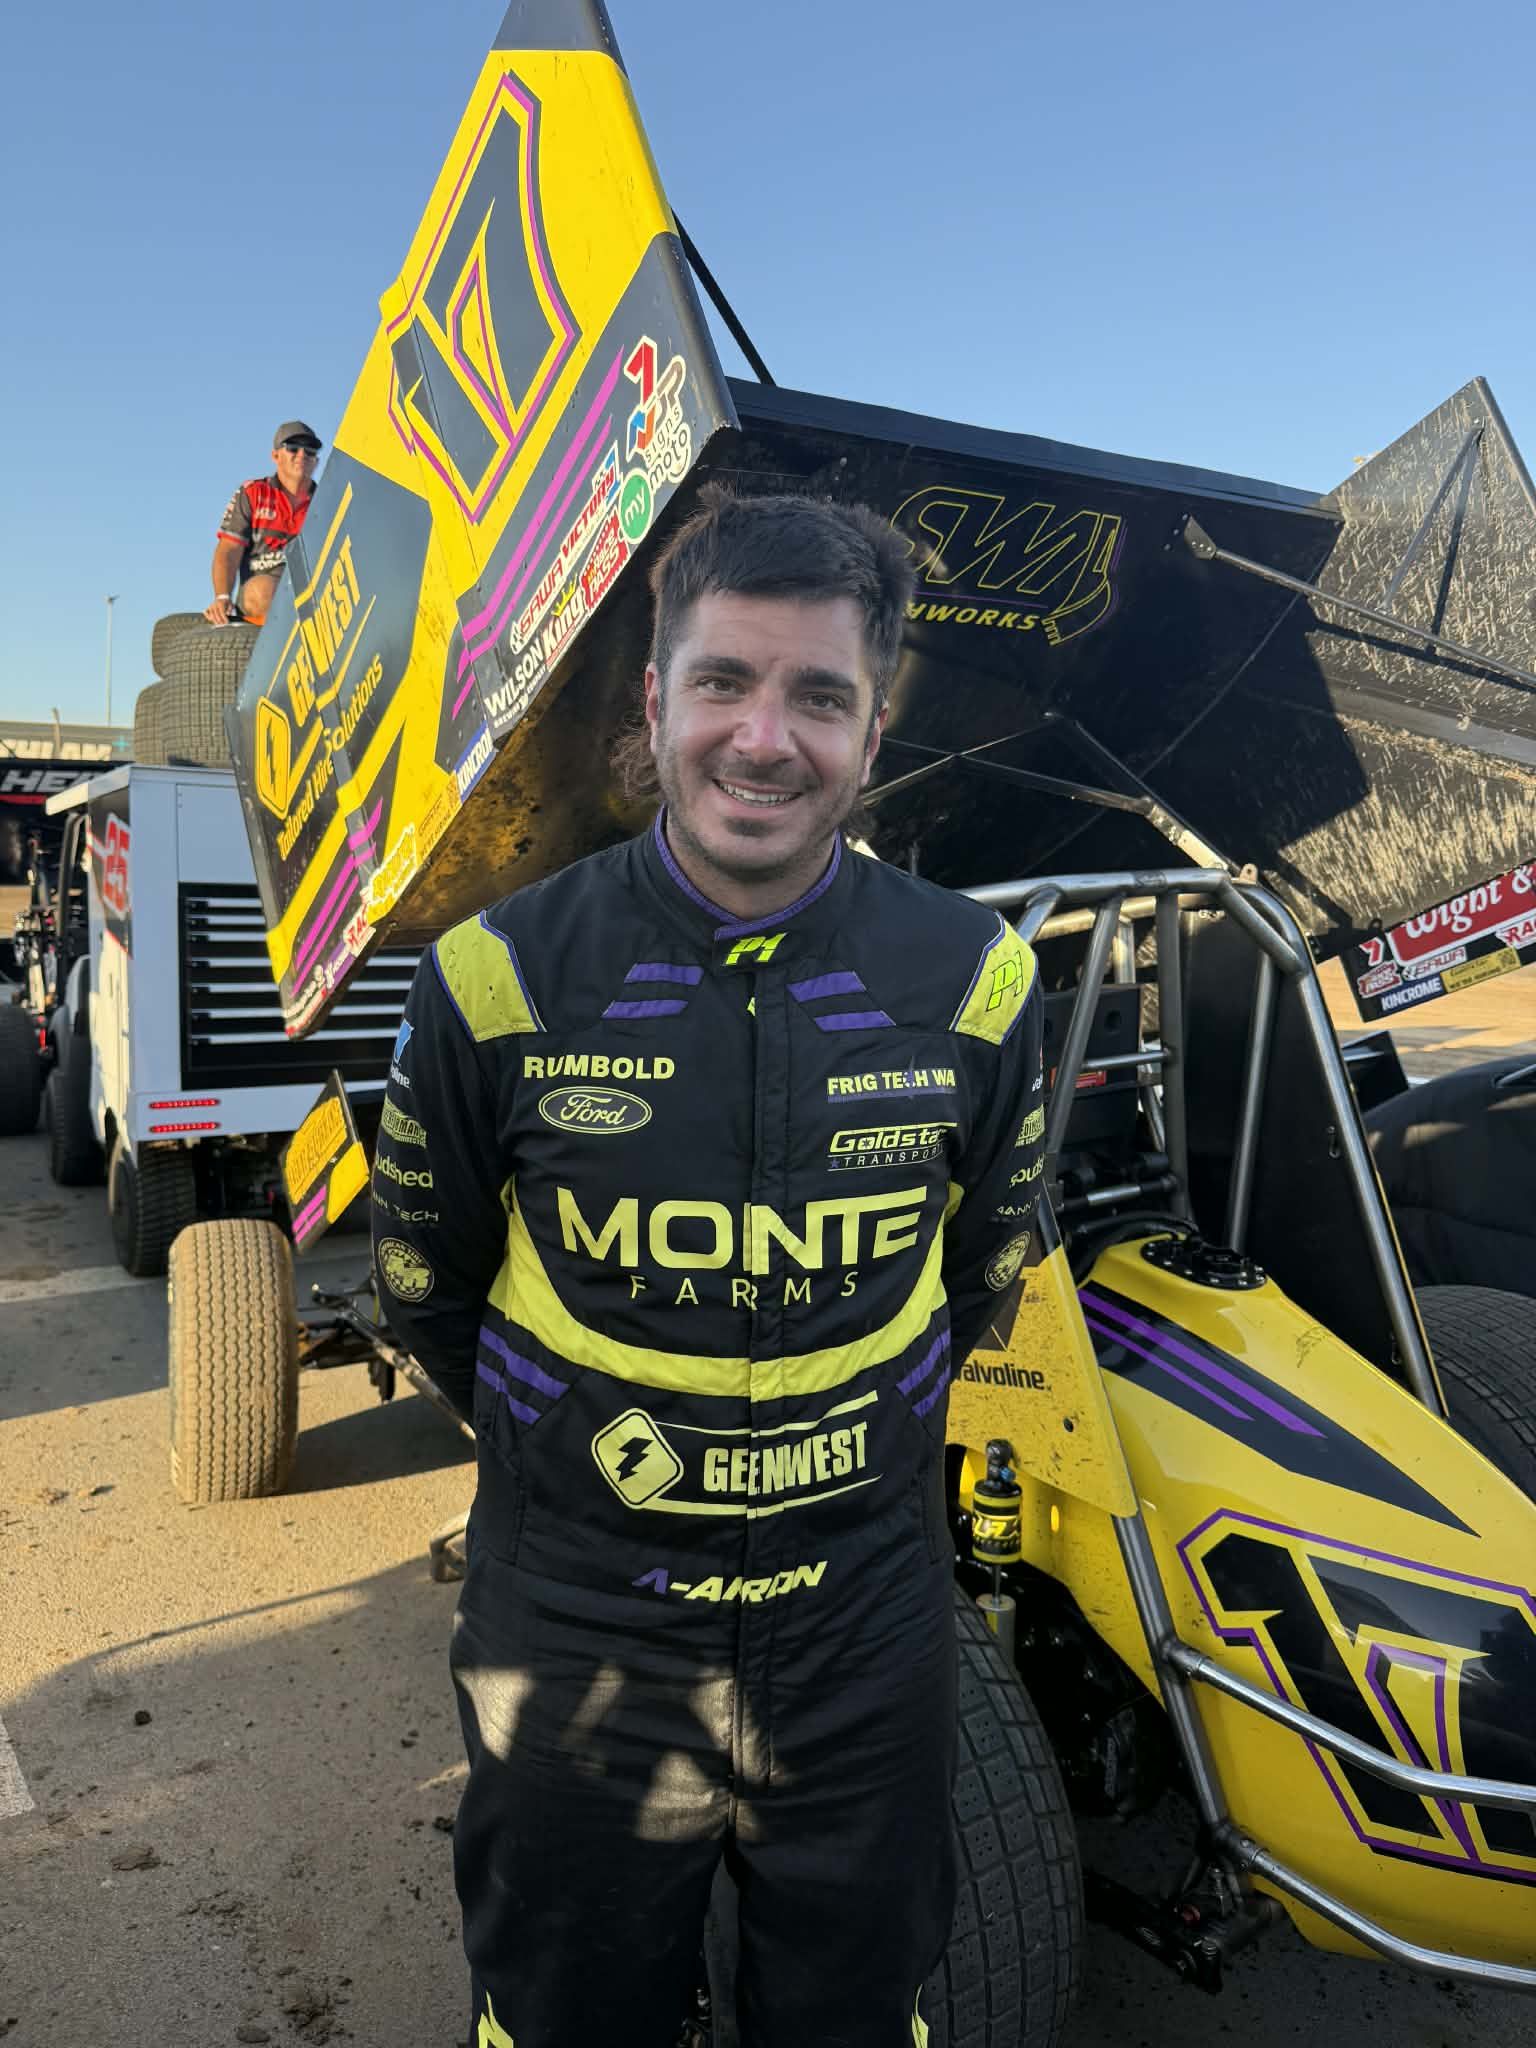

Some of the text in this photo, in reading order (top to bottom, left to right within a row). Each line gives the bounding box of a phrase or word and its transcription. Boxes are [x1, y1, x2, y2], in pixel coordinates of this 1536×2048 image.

[624, 427, 689, 528] my moto
[542, 587, 588, 657] King
[484, 638, 545, 718] WILSON
[1381, 977, 1443, 1011] KINCROME
[524, 1055, 676, 1079] RUMBOLD
[828, 1073, 878, 1095] FRIG
[932, 1068, 956, 1088] WA
[560, 1093, 628, 1127] Ford
[556, 1186, 927, 1275] MONTE
[629, 1271, 859, 1310] FARMS
